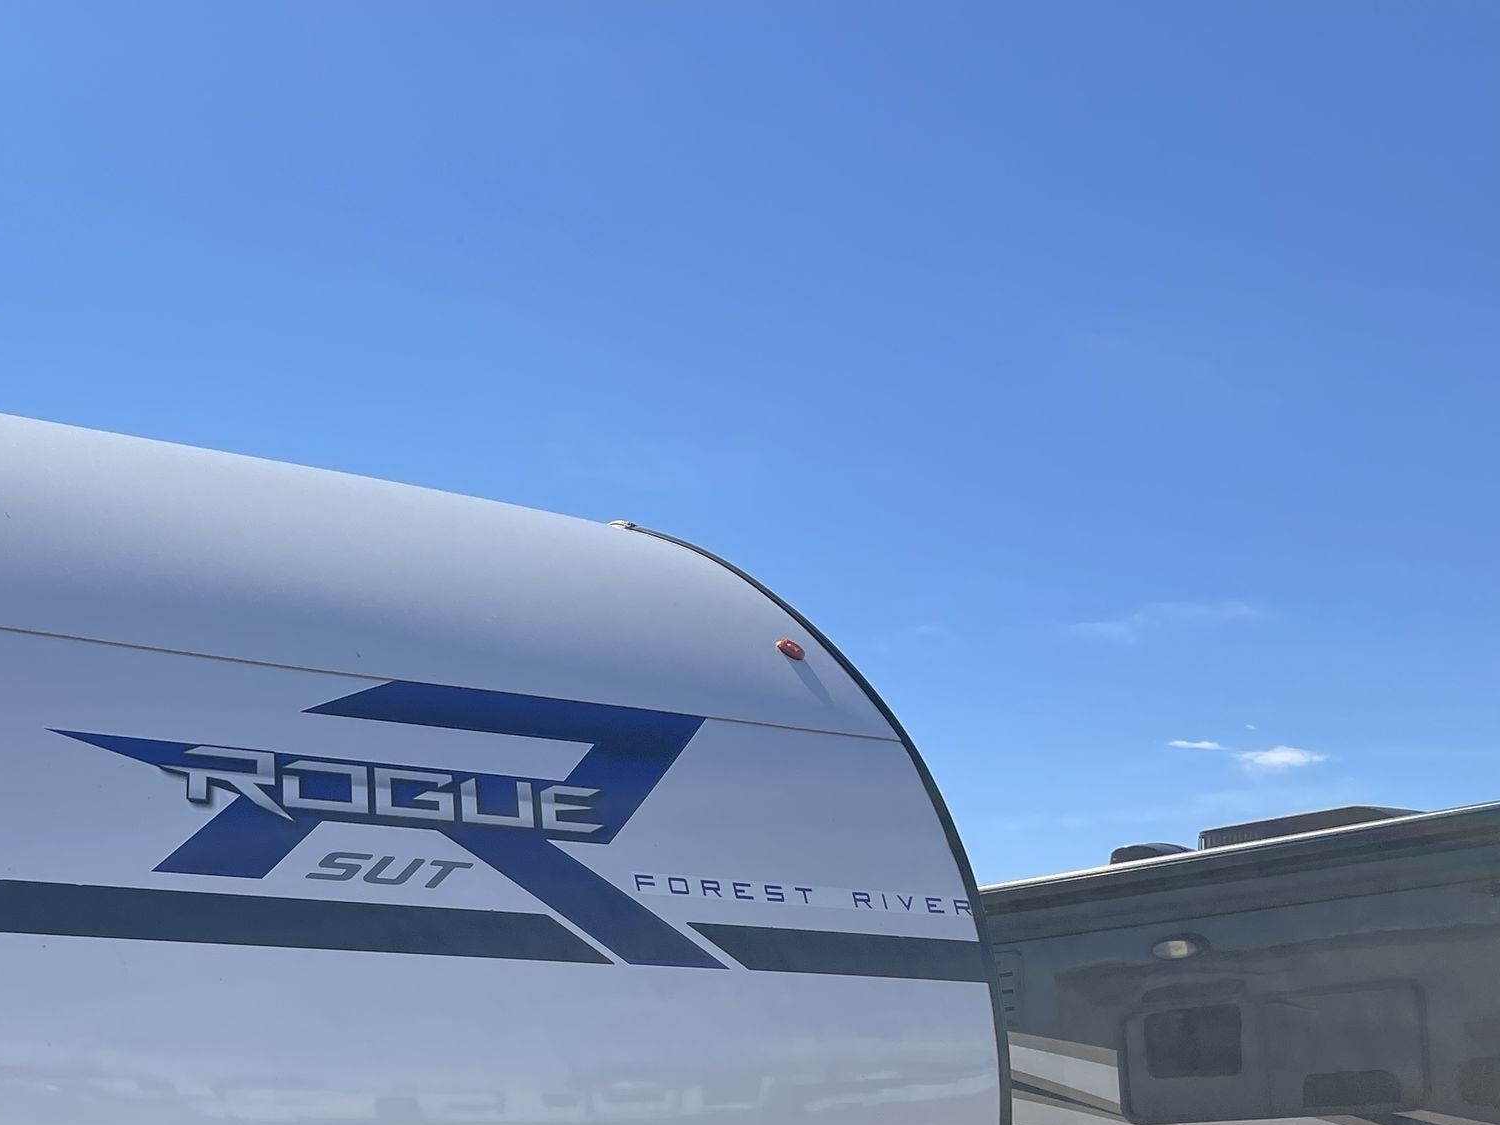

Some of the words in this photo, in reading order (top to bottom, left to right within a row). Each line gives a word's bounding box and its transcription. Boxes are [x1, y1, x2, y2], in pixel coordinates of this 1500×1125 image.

[160, 745, 604, 833] ROGUE
[304, 851, 474, 889] SUT
[633, 873, 813, 905] FOREST
[851, 891, 973, 917] RIVER
